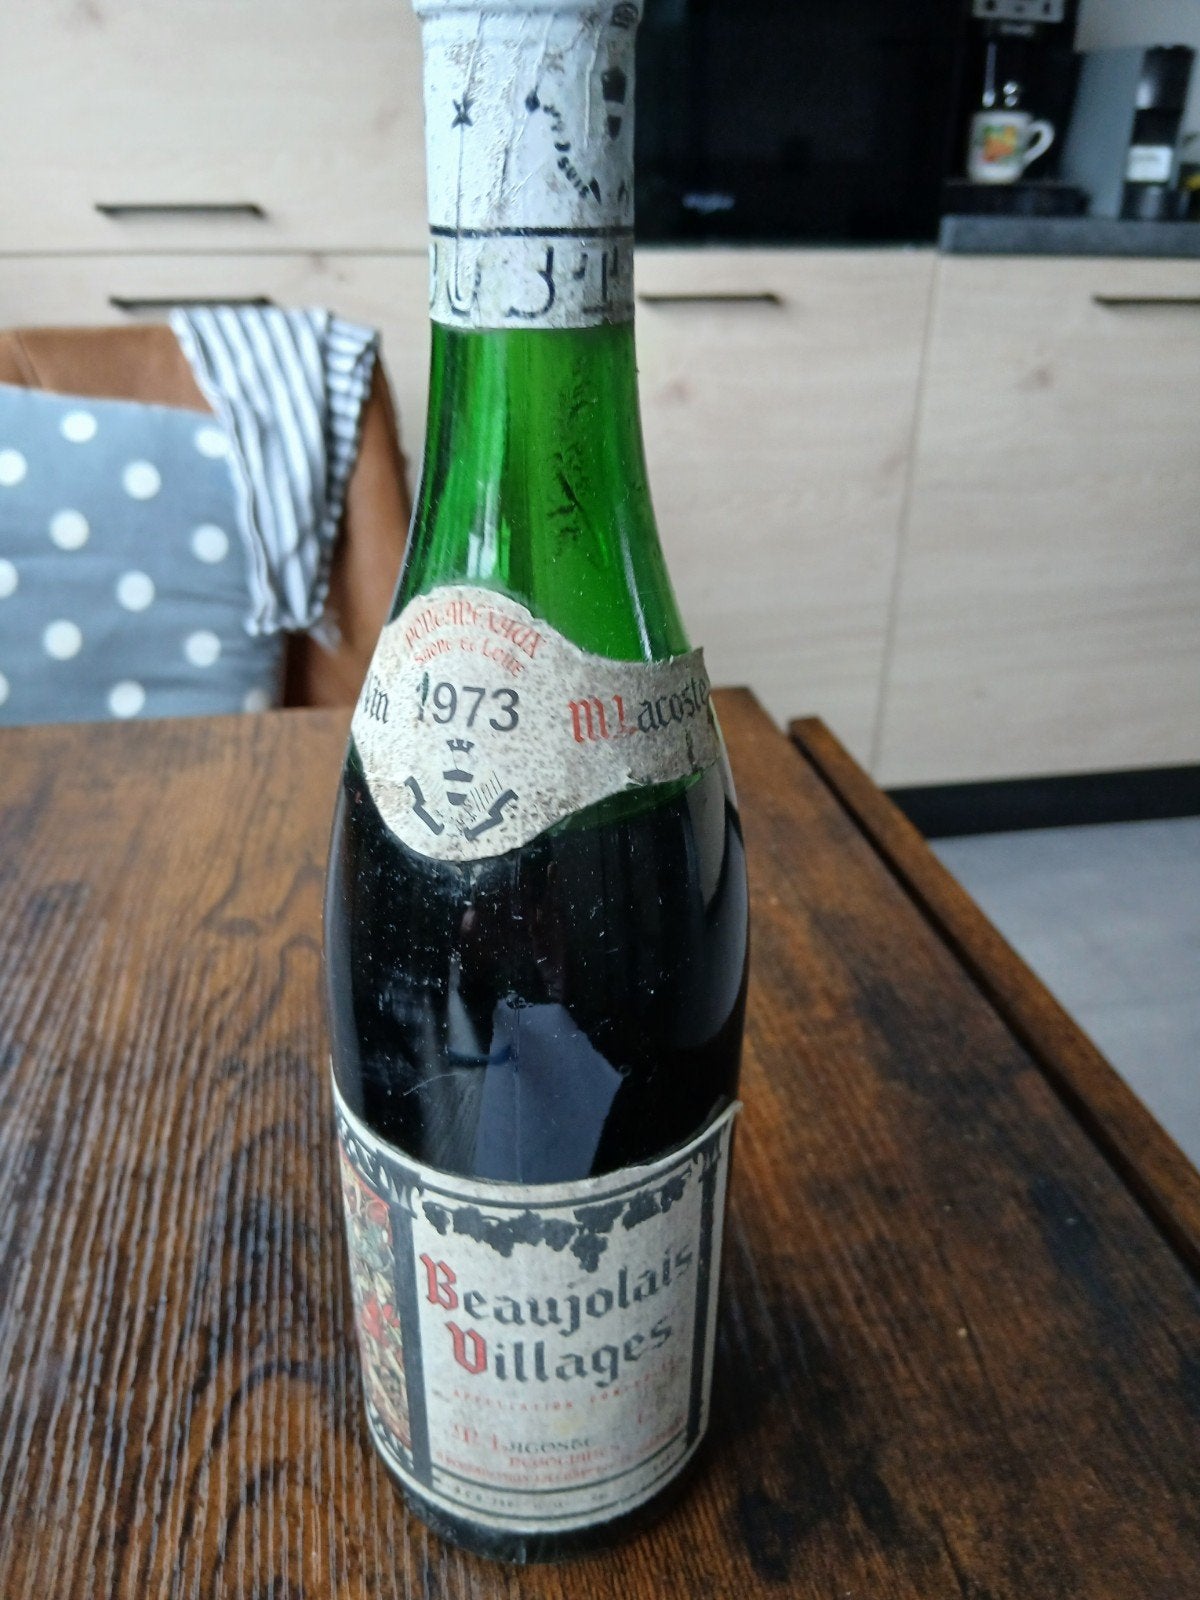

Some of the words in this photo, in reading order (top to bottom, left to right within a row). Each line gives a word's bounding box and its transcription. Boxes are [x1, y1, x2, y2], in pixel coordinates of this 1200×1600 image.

[415, 672, 519, 731] 1973
[418, 1245, 692, 1337] Beaujolais
[445, 1314, 672, 1388] Villages
